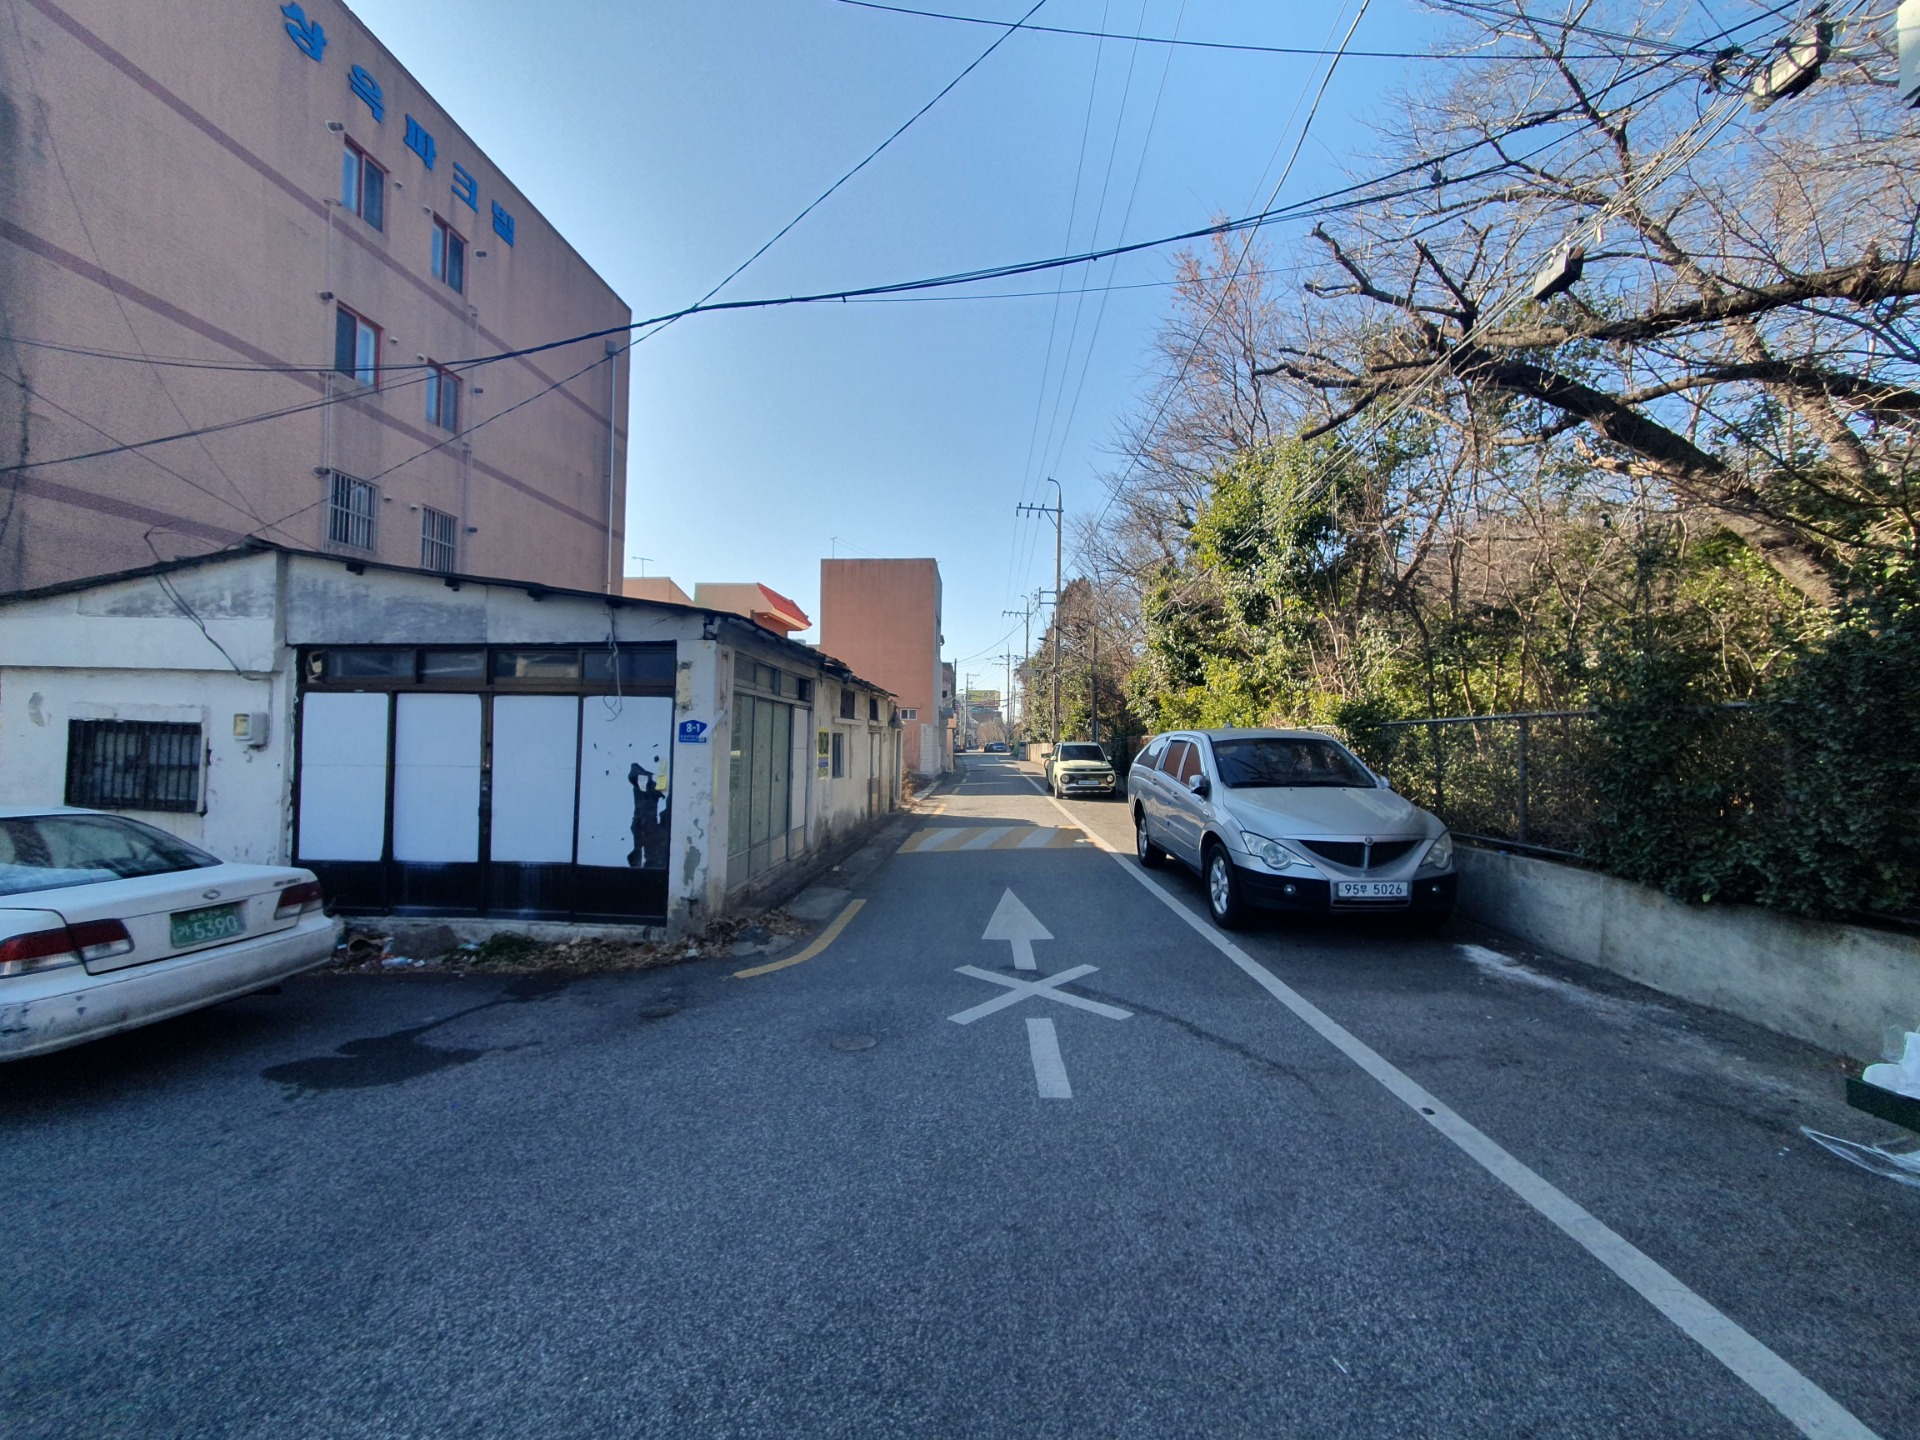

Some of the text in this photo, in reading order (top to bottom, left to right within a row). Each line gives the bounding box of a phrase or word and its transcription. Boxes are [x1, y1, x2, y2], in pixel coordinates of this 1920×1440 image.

[686, 722, 700, 733] 8-1
[1344, 883, 1403, 895] 95무 5026
